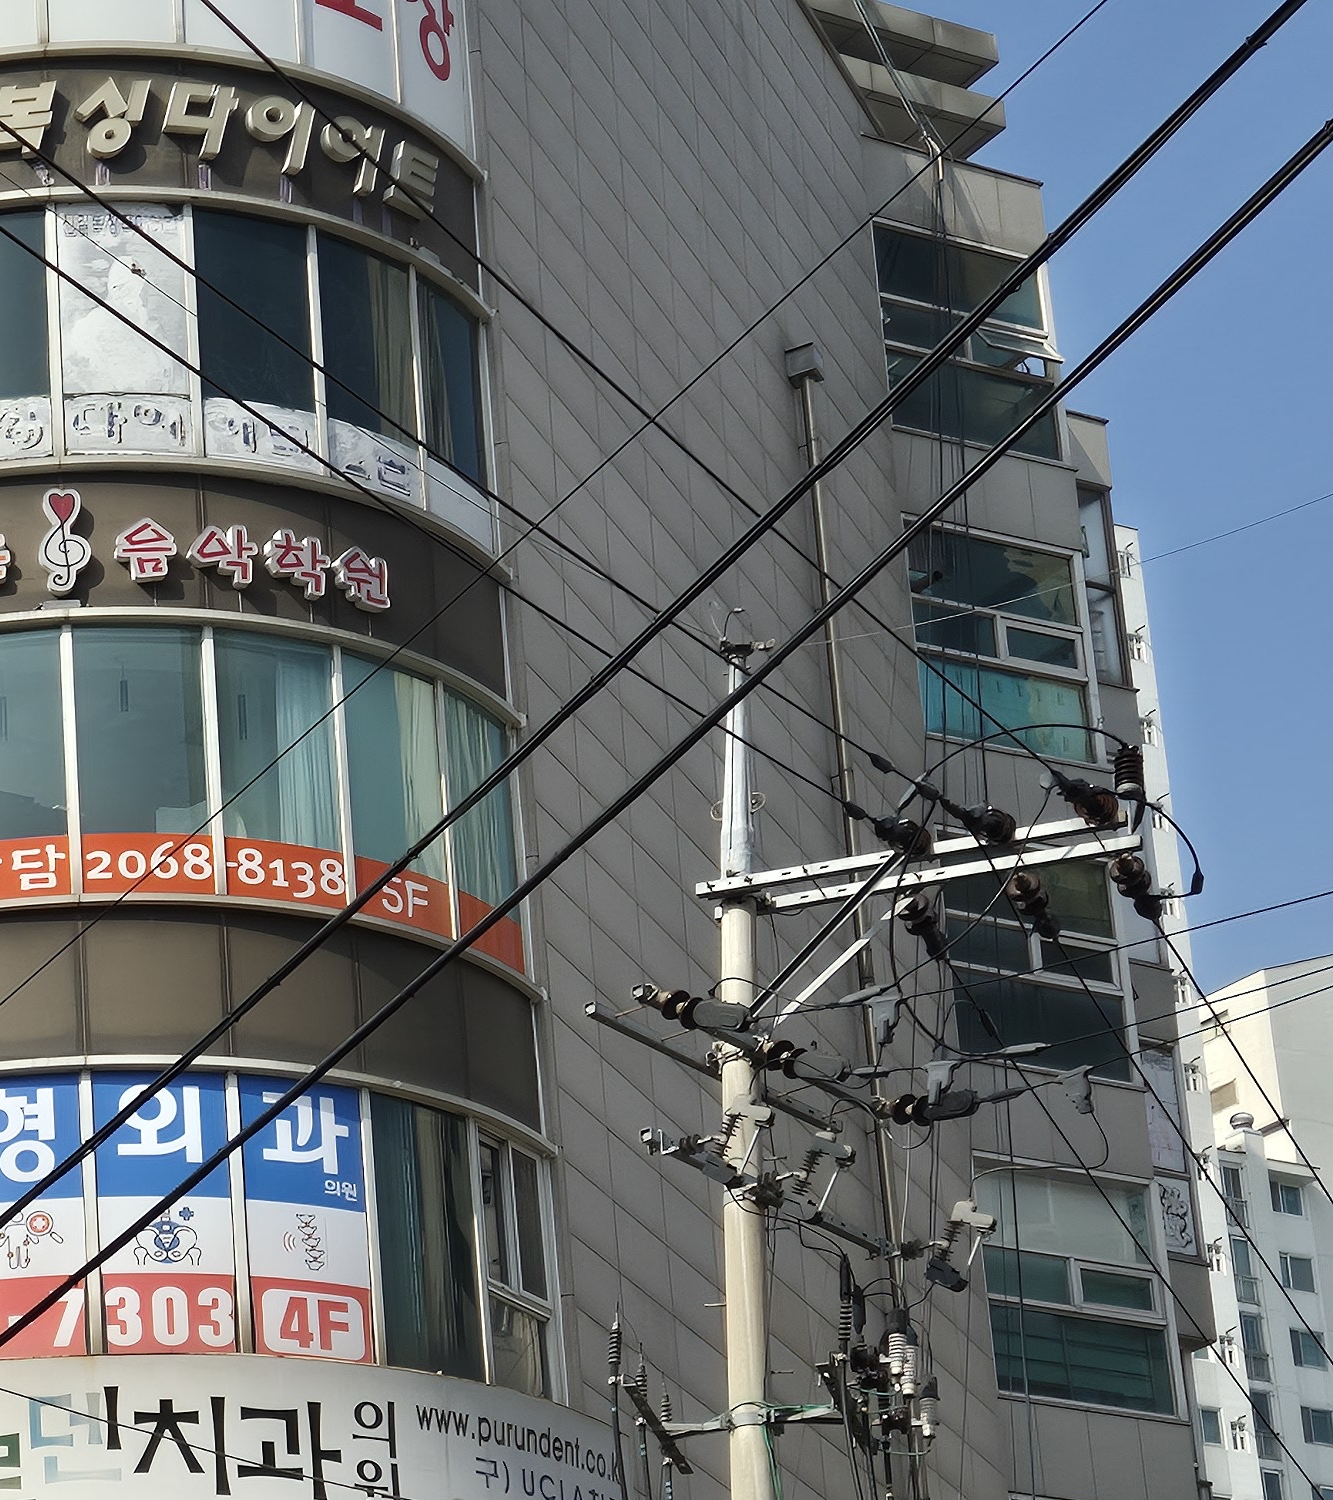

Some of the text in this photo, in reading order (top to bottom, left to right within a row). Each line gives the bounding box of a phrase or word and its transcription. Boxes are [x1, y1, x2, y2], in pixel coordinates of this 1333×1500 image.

[114, 518, 392, 613] 음악학원
[87, 841, 346, 897] 2068-8138
[381, 874, 430, 917] 5F
[323, 1180, 358, 1202] 의원
[283, 1298, 358, 1349] 4F
